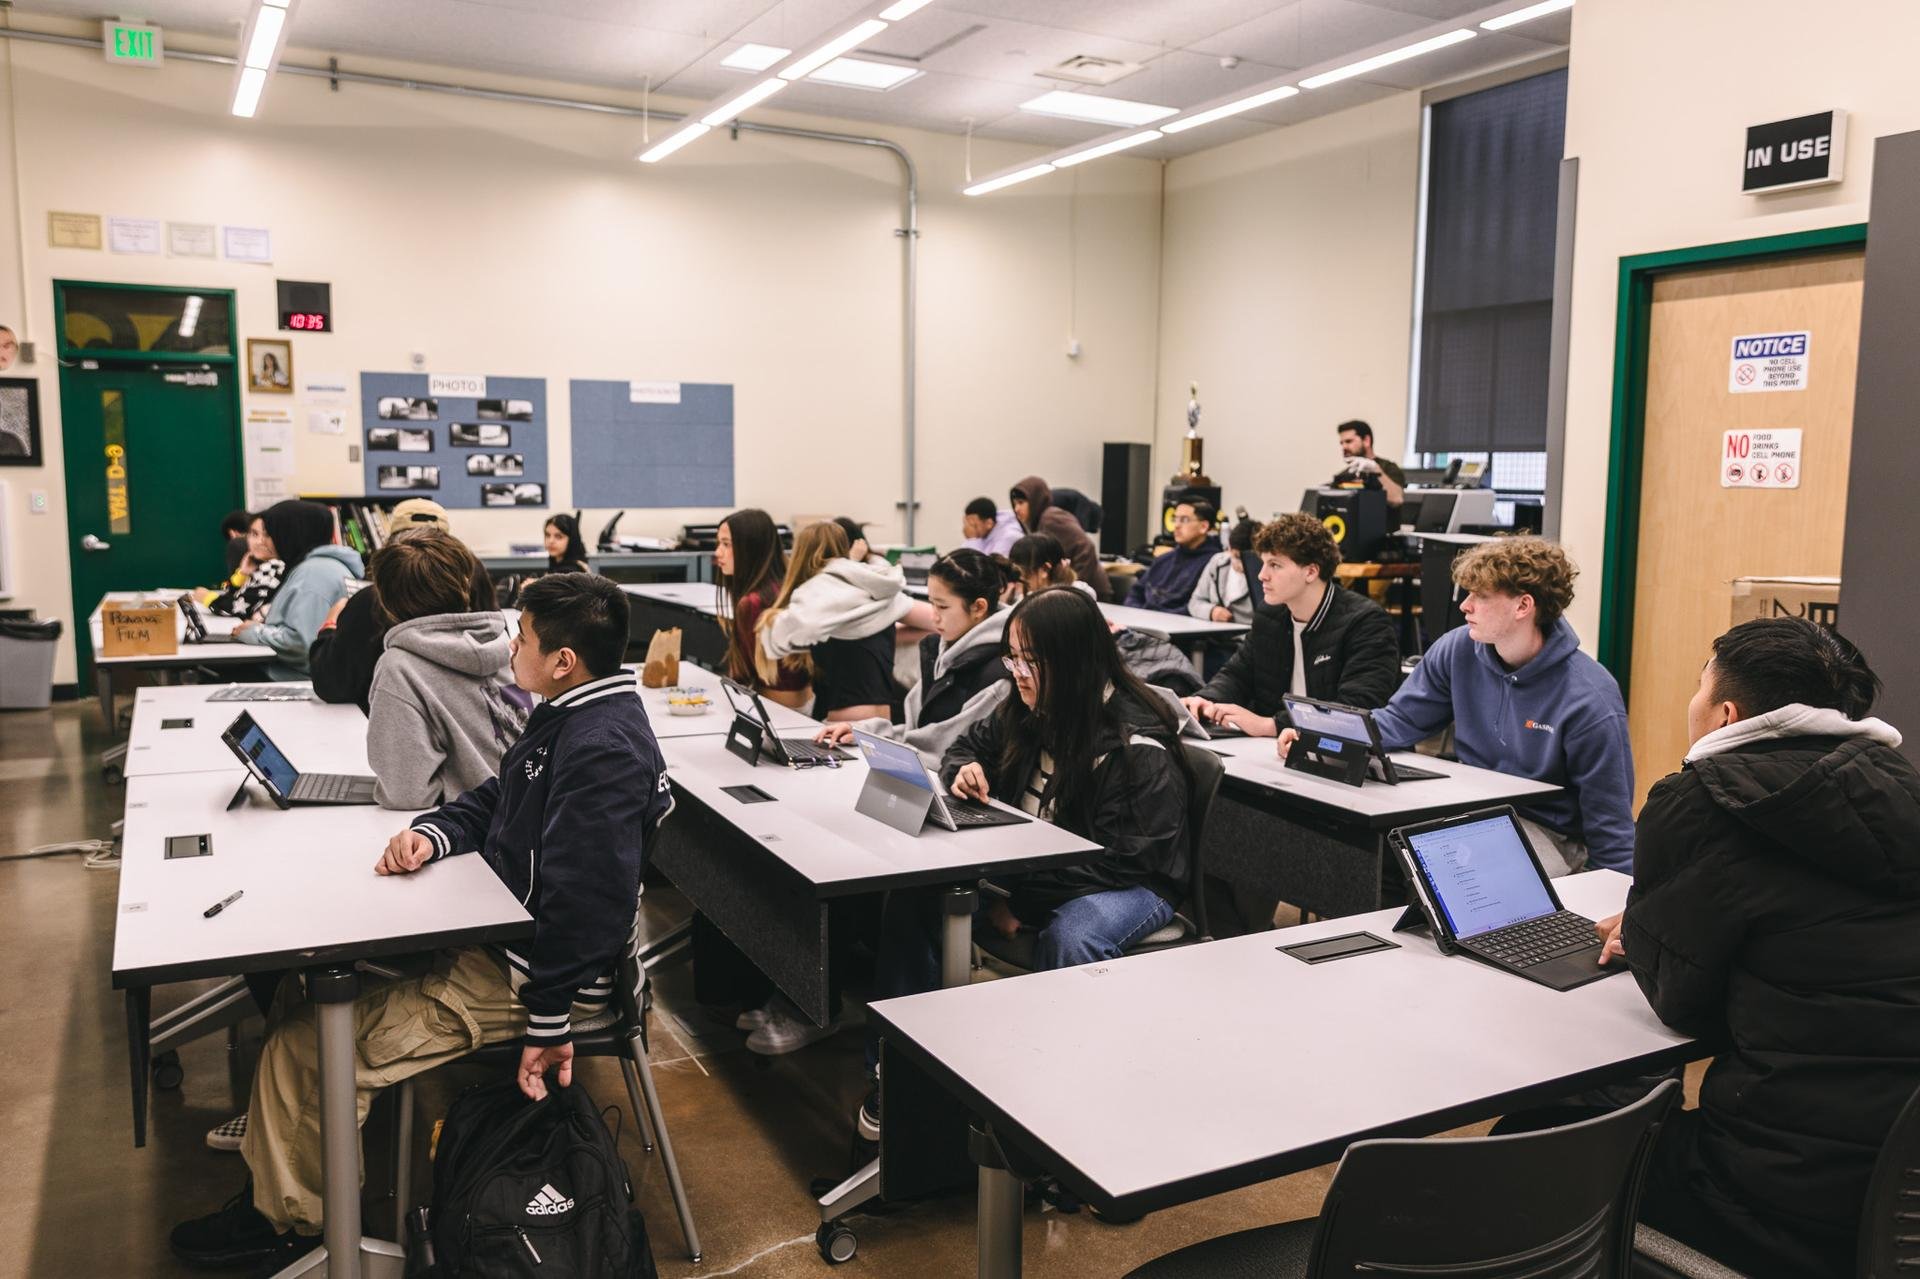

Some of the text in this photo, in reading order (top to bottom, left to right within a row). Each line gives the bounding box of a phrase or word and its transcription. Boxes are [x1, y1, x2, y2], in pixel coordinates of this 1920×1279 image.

[115, 27, 153, 59] EXIT
[1747, 135, 1830, 169] IN USE
[1736, 336, 1805, 357] NOTICE
[1788, 364, 1802, 372] USE
[1769, 372, 1796, 380] BEYOND
[432, 379, 477, 392] PHOTO
[1780, 379, 1800, 387] POINT
[1752, 433, 1772, 441] FOOD
[1727, 434, 1750, 459] NO
[1752, 442, 1780, 450] DRINKS
[1751, 451, 1797, 459] CELL PHONE
[525, 1198, 575, 1215] adidas
